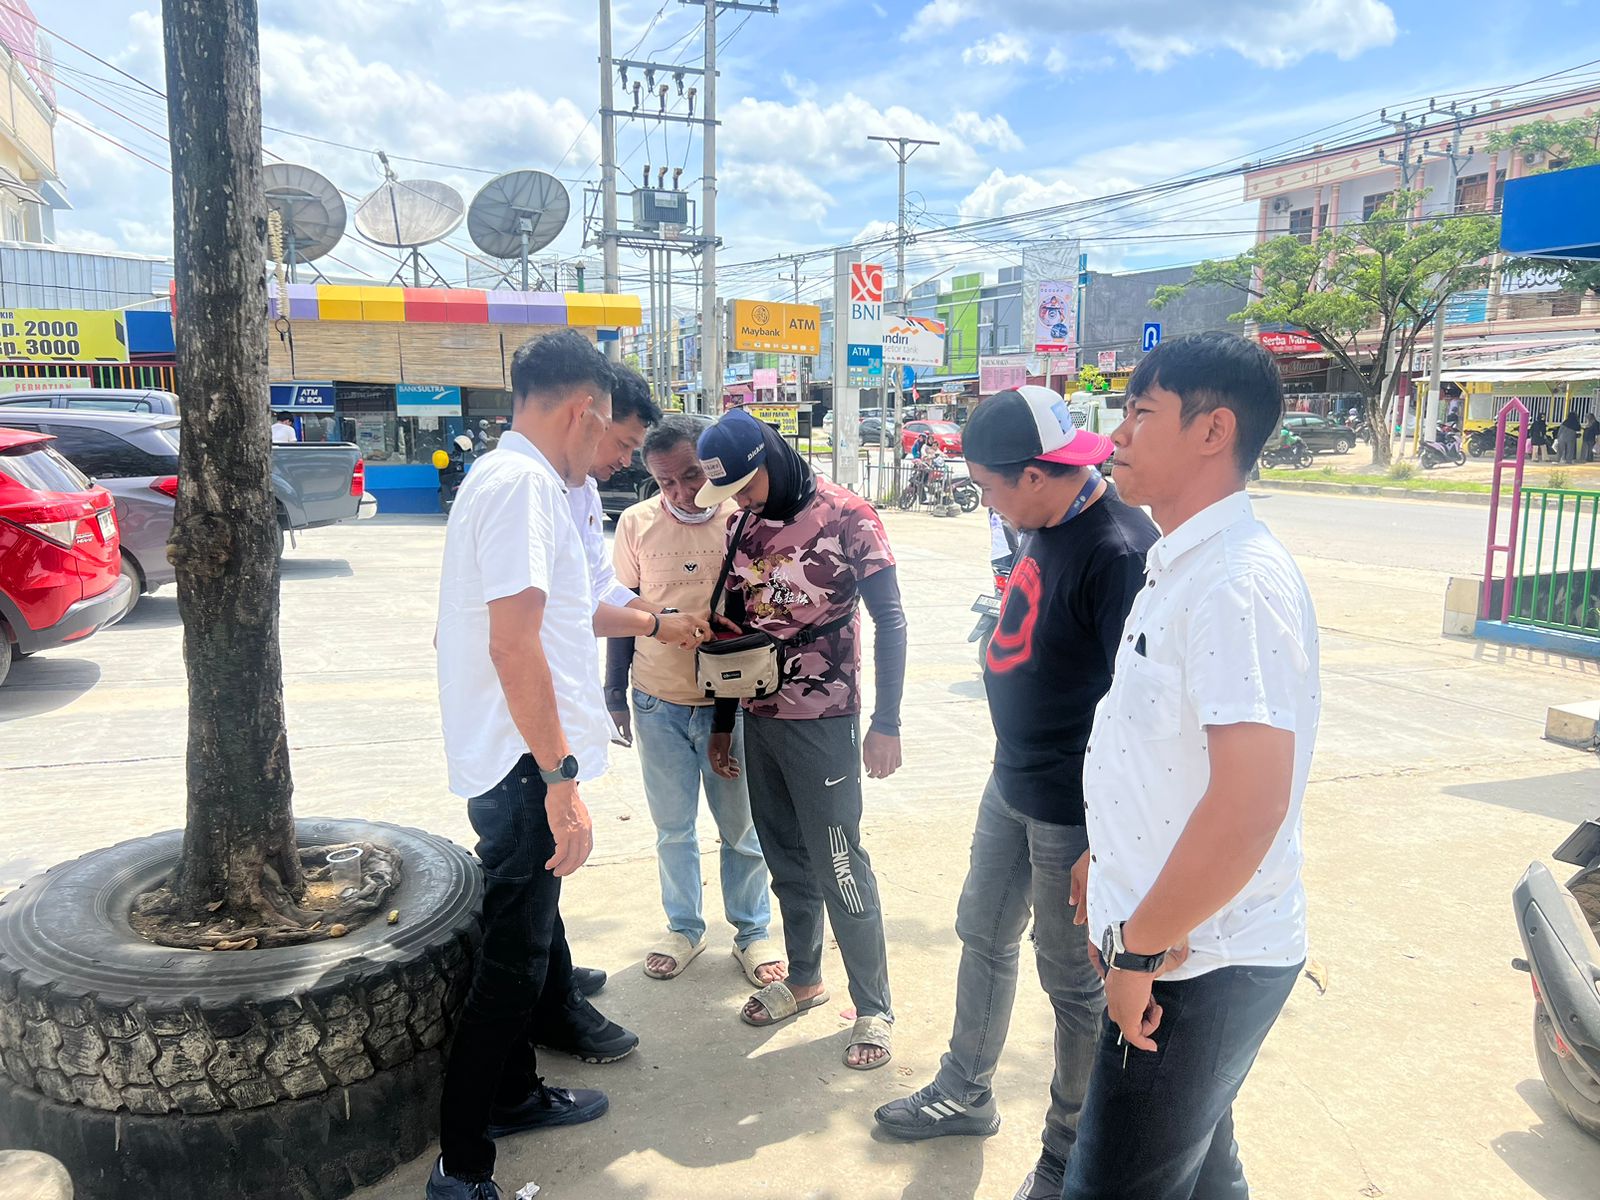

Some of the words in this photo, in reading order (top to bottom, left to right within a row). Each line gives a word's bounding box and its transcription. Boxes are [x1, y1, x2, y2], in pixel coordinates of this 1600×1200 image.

[852, 303, 881, 321] BNI
[0, 323, 20, 337] p.
[25, 320, 78, 337] 2000
[789, 319, 816, 331] ATM
[742, 327, 780, 337] Maybank
[1263, 336, 1285, 346] Serba
[26, 339, 80, 356] 3000
[852, 347, 870, 357] ATM
[301, 389, 319, 397] ATM
[399, 385, 445, 393] BANKSULTRA
[306, 396, 323, 404] BCA
